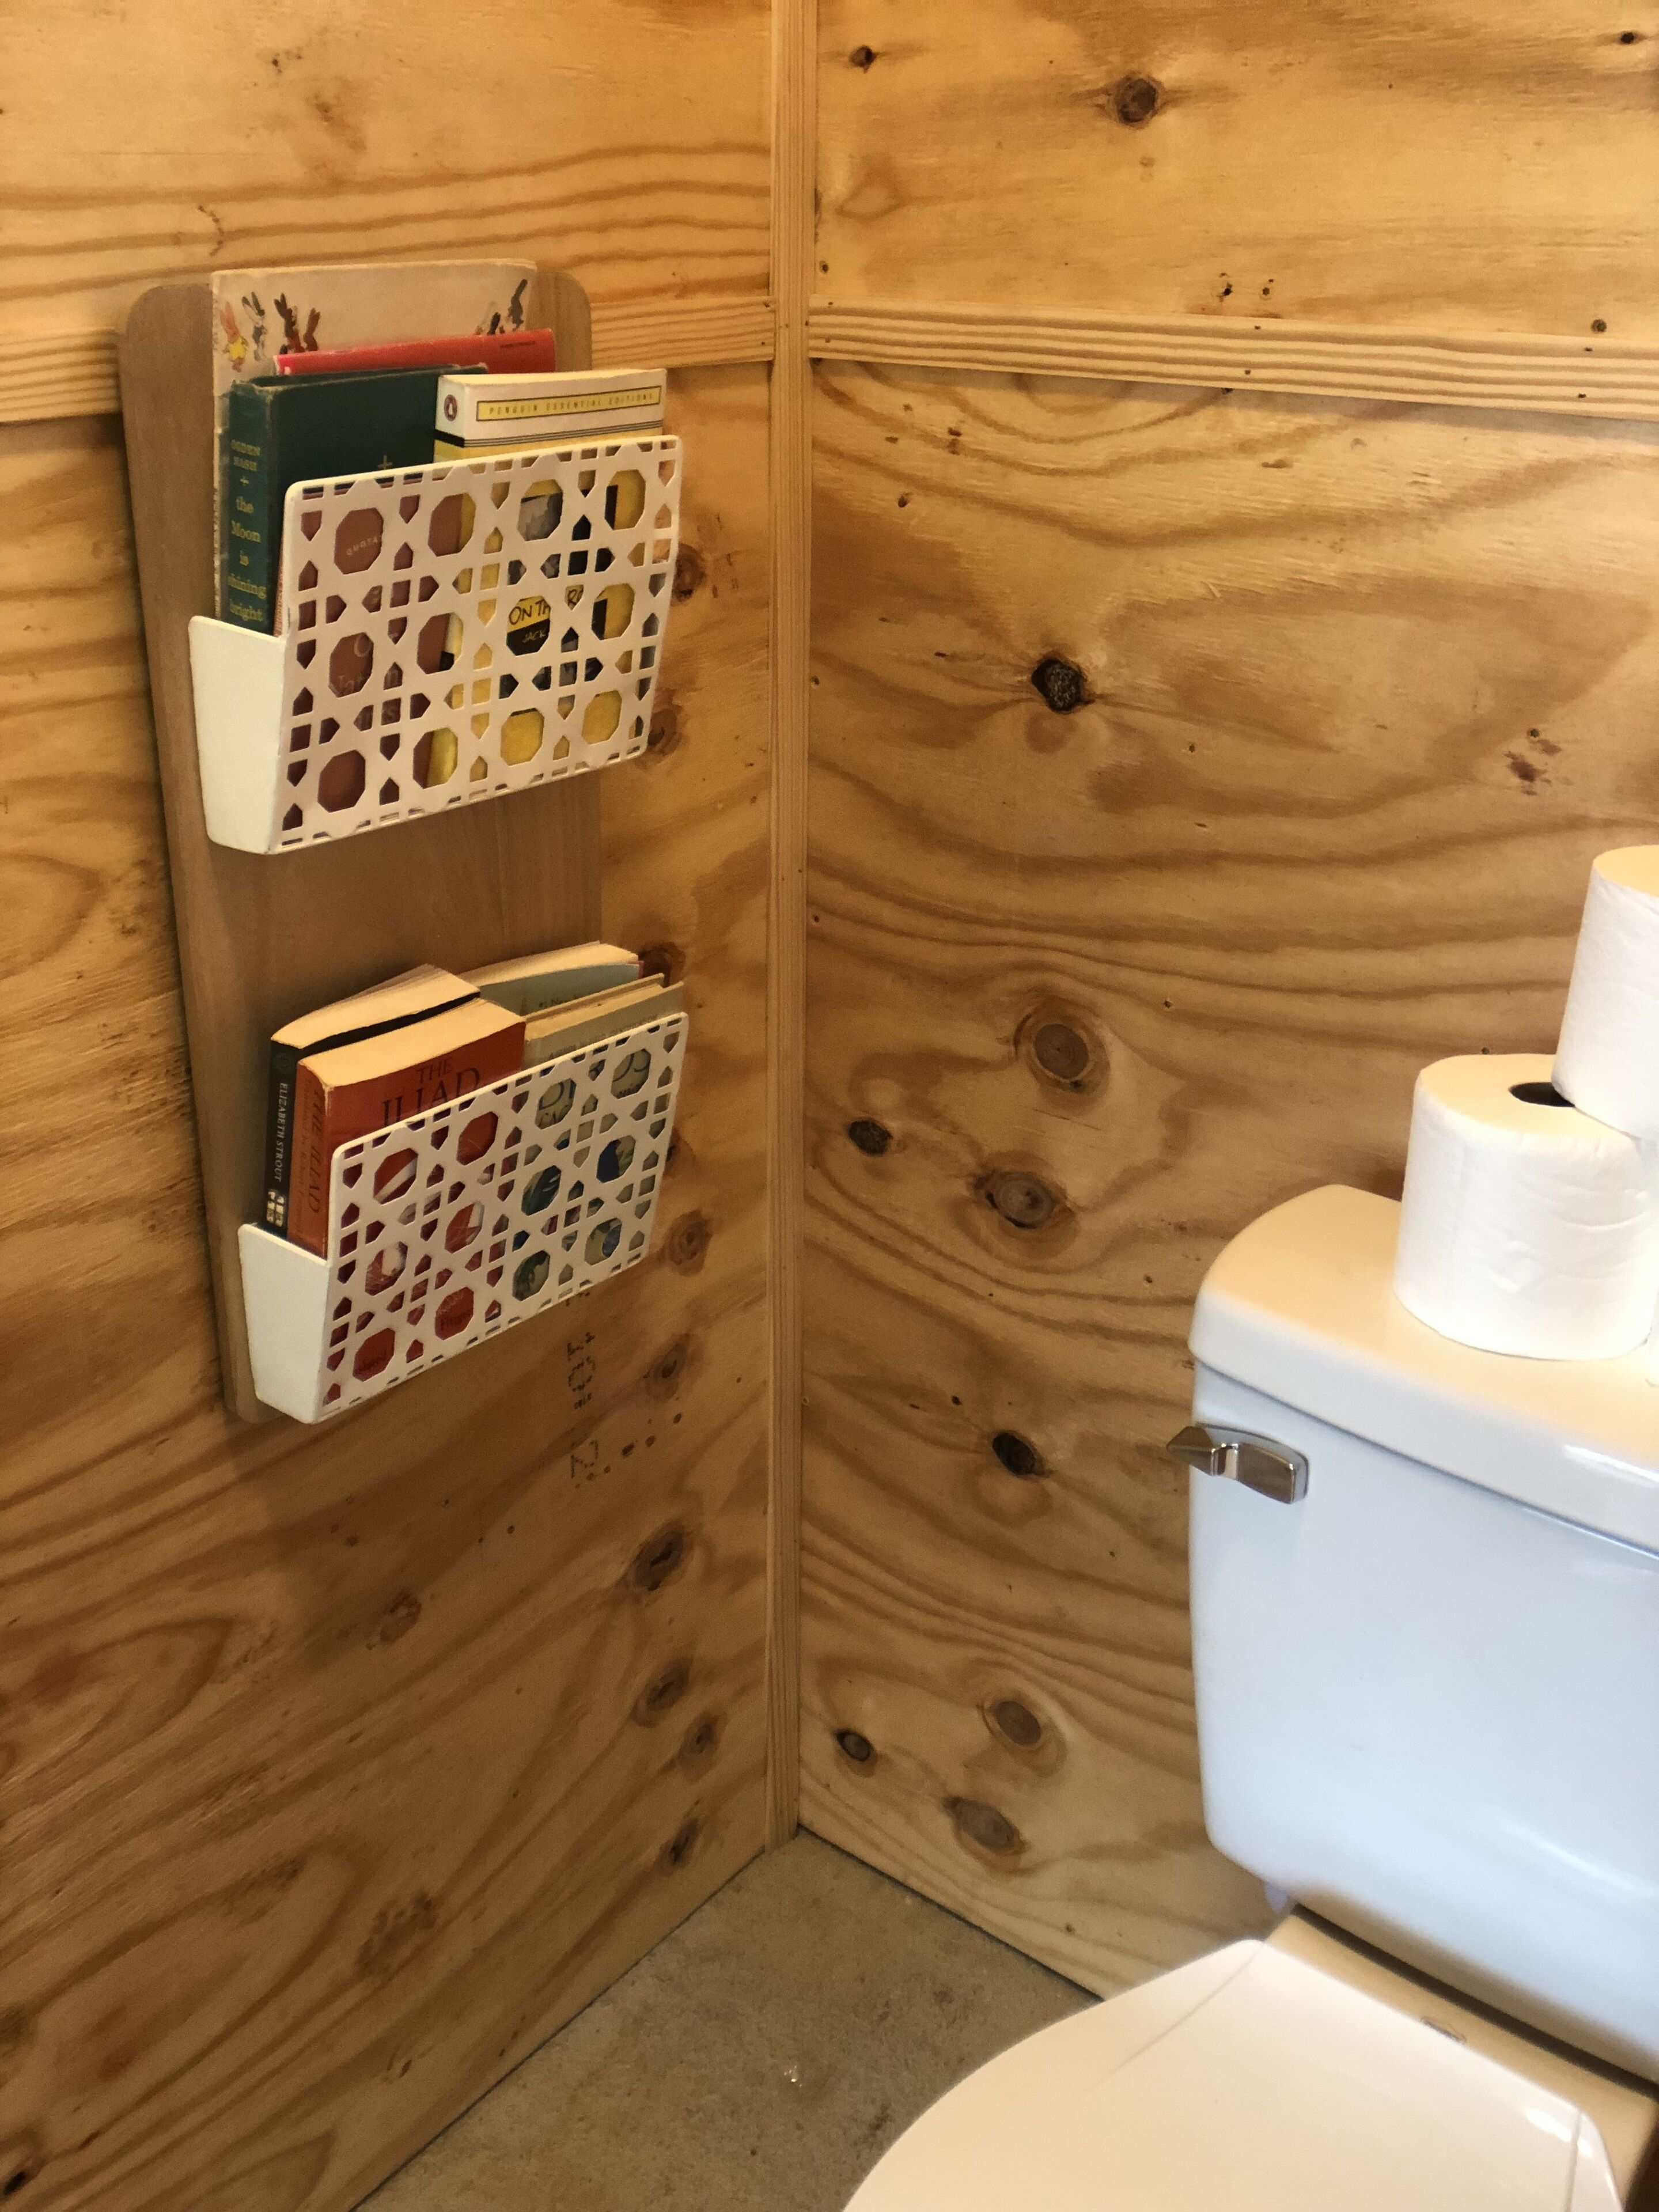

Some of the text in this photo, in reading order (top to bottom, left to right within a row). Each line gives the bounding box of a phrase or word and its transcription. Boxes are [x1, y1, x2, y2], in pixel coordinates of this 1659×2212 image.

[489, 404, 537, 415] PENGUIN
[546, 399, 601, 412] ESSENTIAL
[236, 496, 255, 514] the
[230, 520, 262, 543] Moon
[238, 551, 249, 567] is
[229, 599, 264, 622] bright
[508, 605, 533, 626] ON
[416, 1058, 453, 1084] THE
[274, 1082, 289, 1183] ELIZABETH STROUT
[308, 1088, 324, 1213] THE ILIAD
